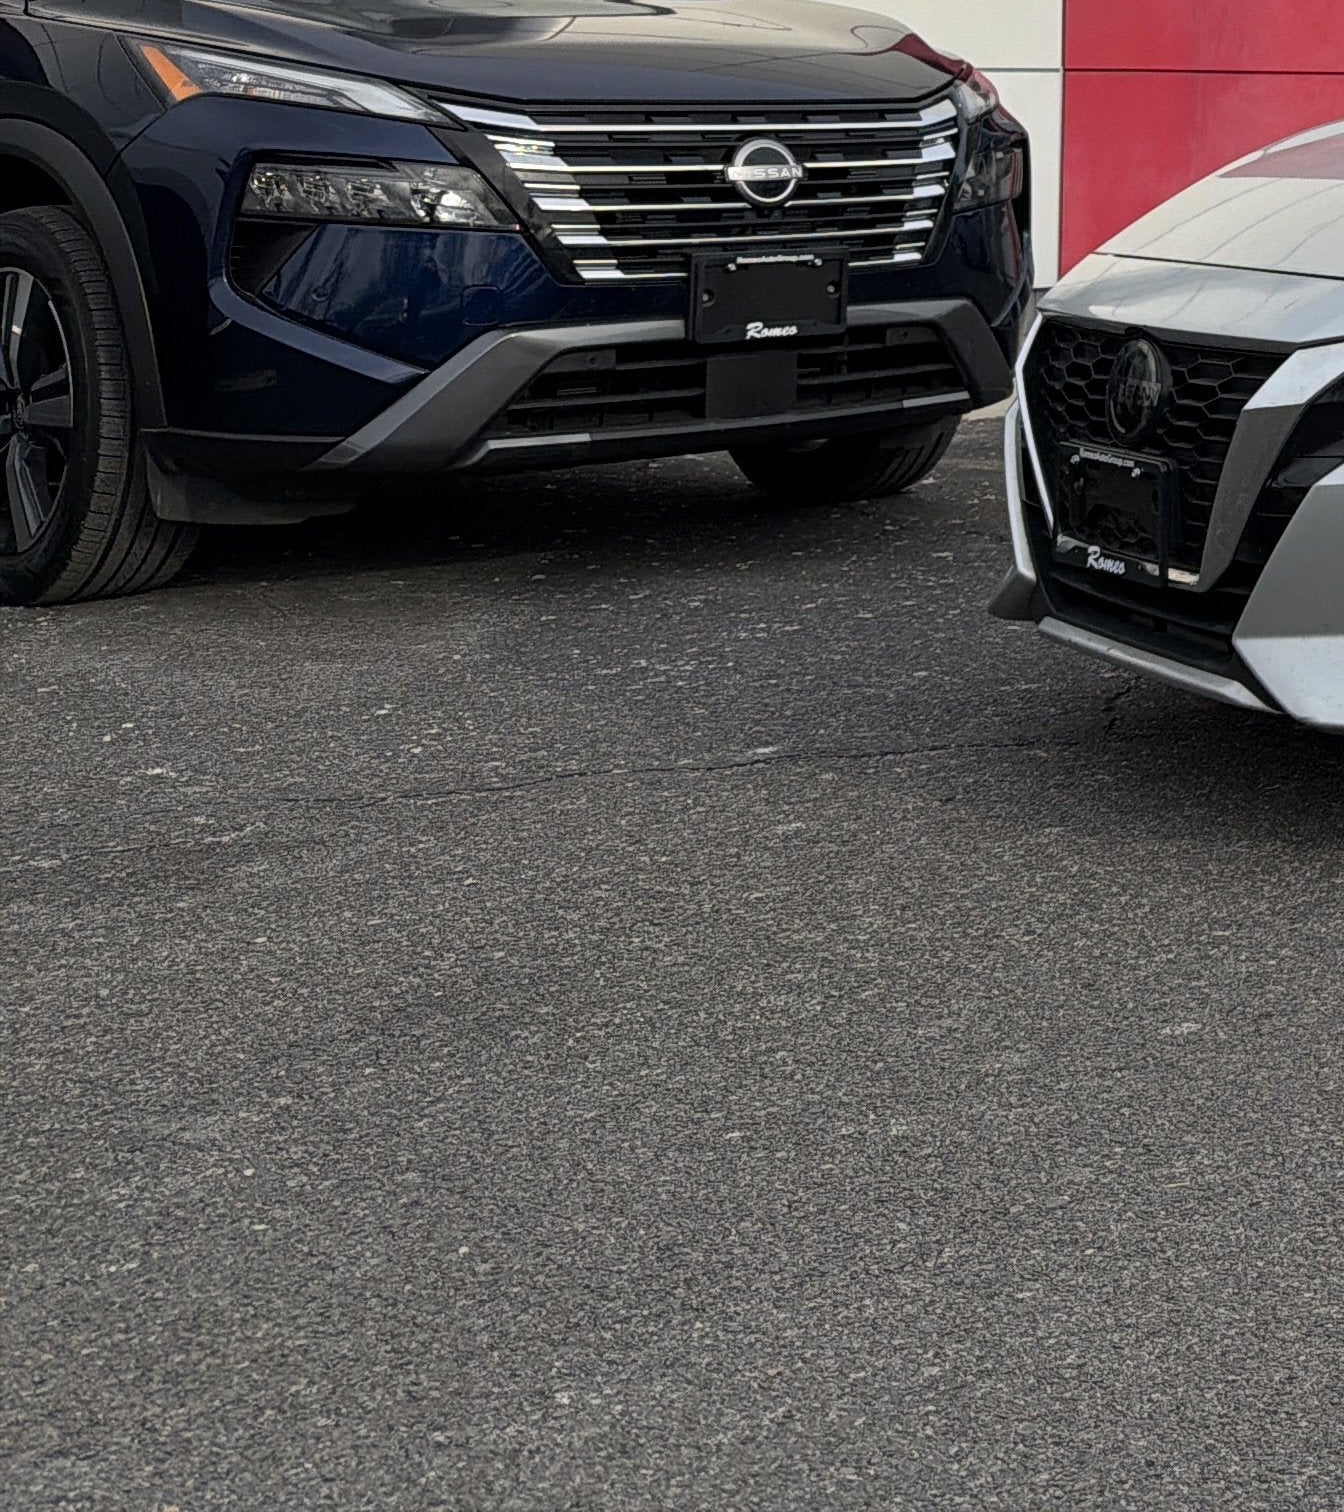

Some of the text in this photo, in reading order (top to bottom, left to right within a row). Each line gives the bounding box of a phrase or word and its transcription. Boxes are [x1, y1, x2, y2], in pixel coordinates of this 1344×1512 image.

[733, 167, 802, 179] NISSAN
[746, 321, 798, 339] Romeo
[1086, 545, 1126, 575] Romeo
